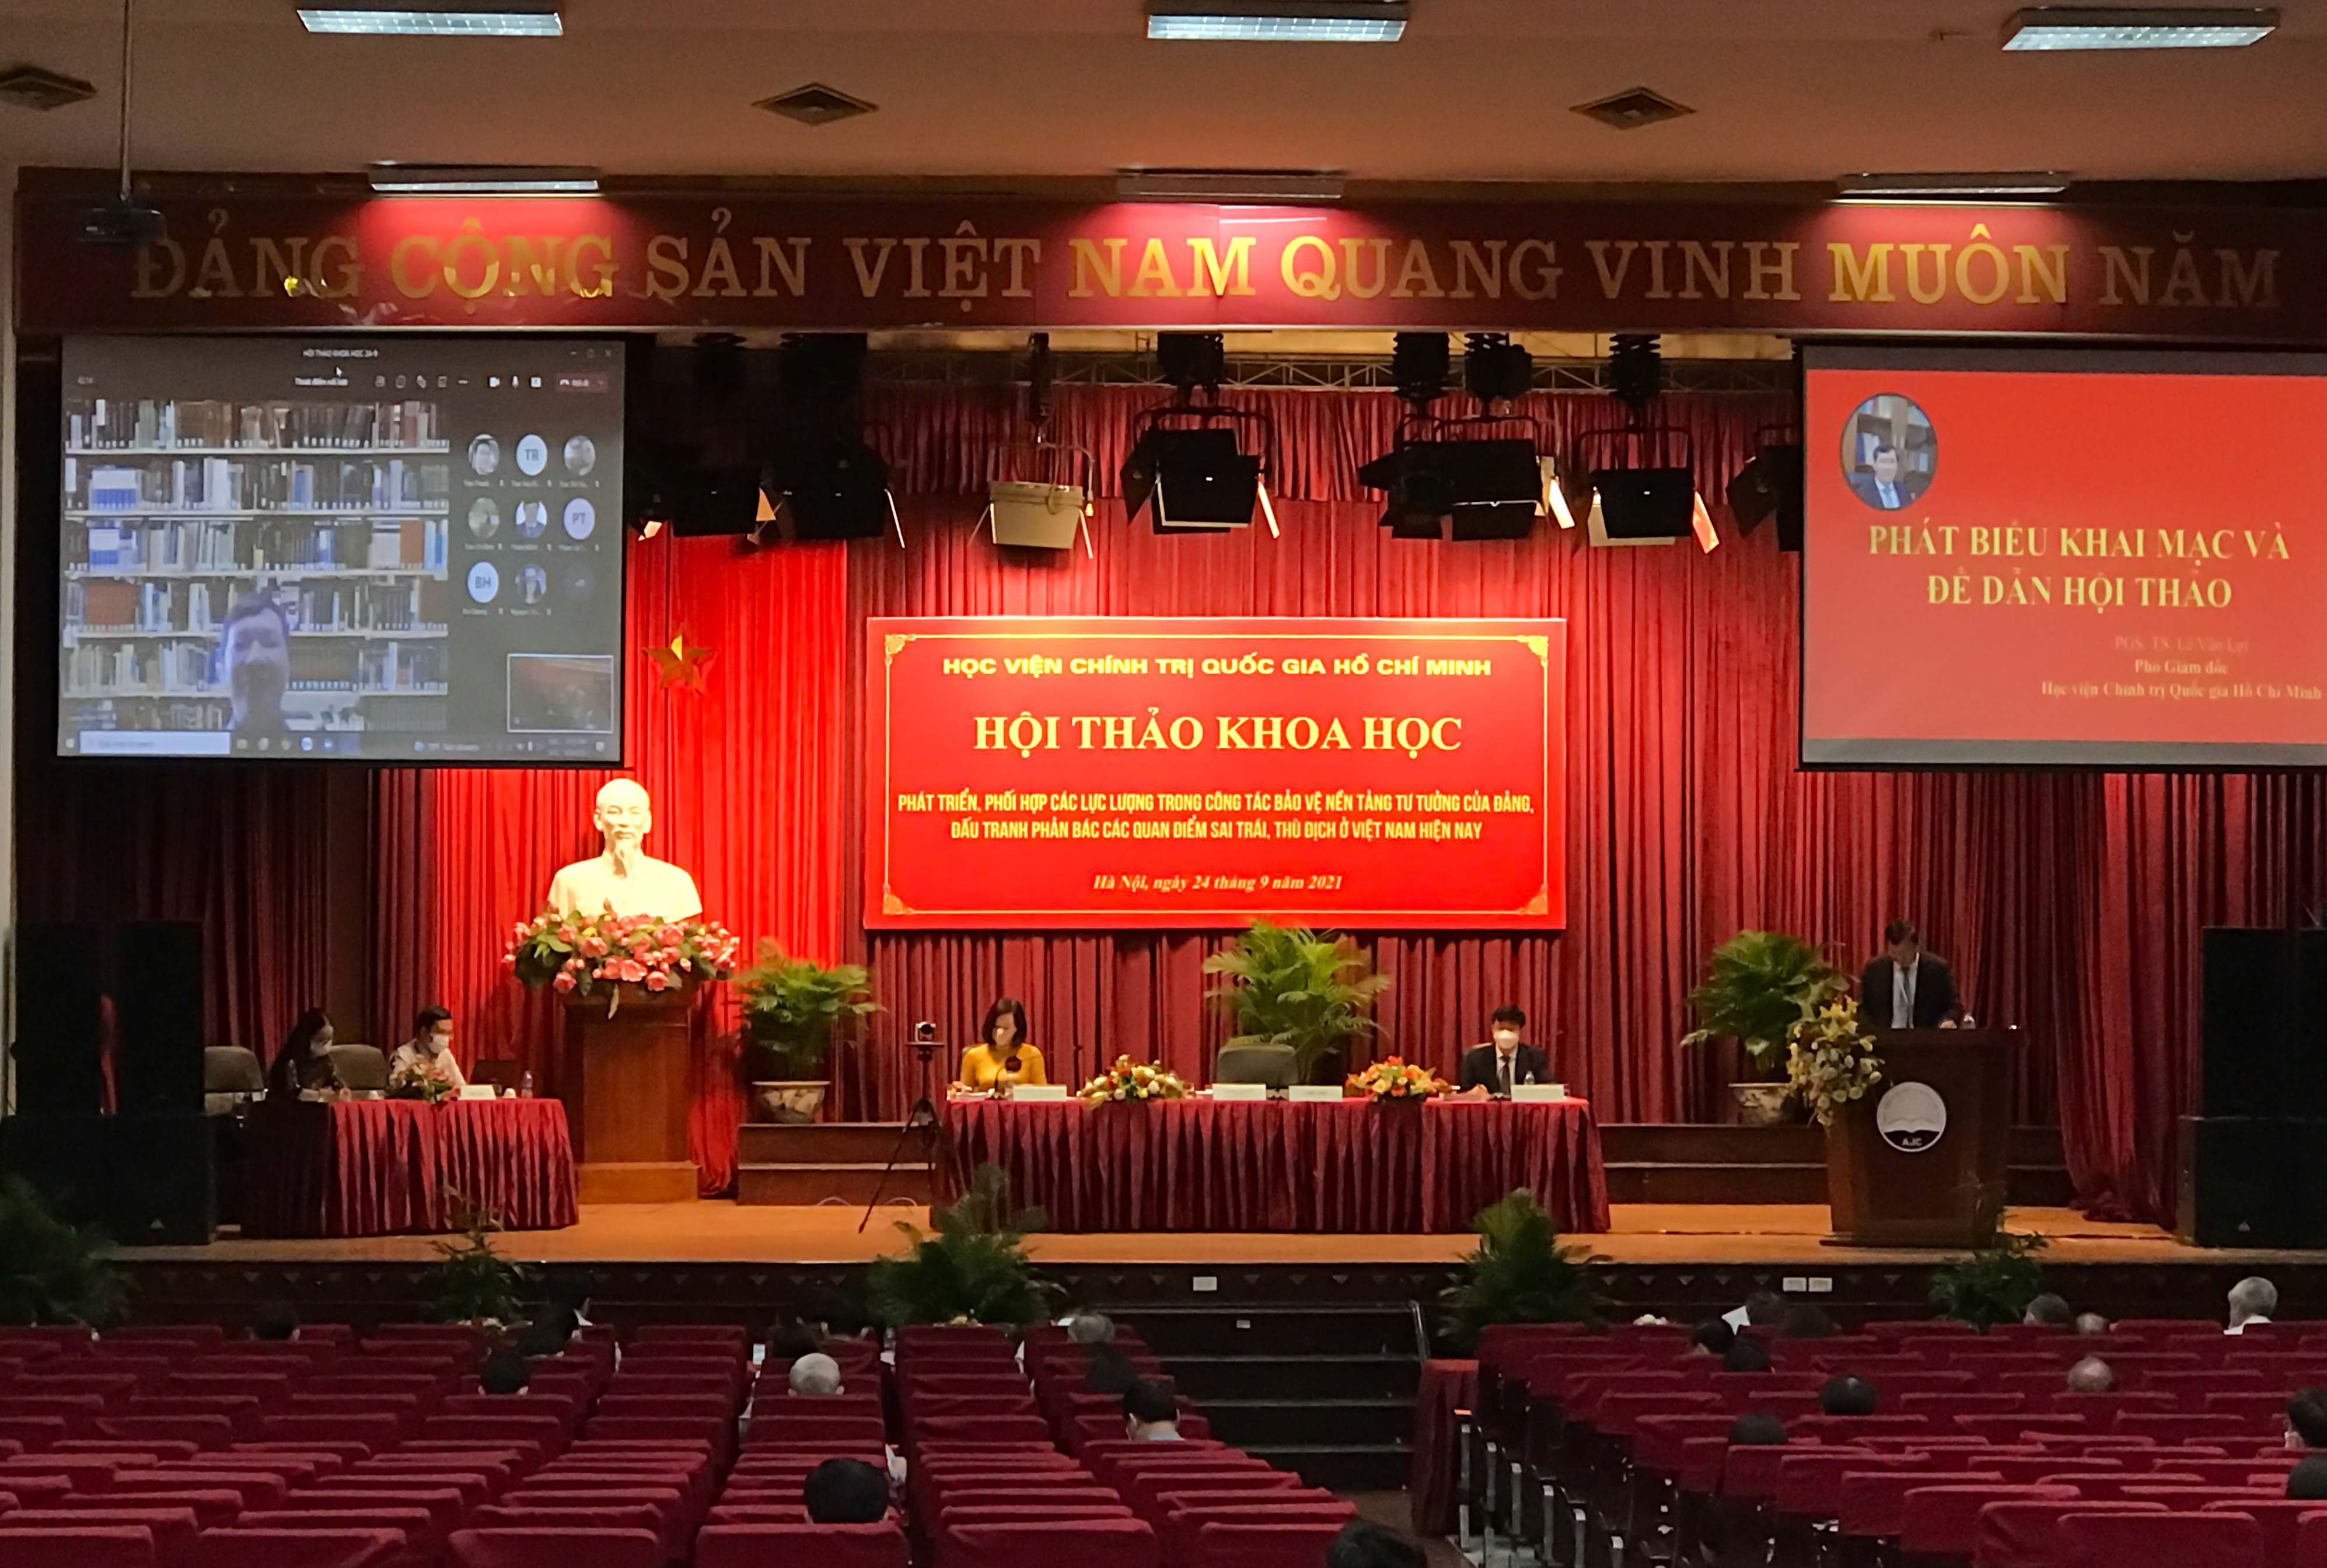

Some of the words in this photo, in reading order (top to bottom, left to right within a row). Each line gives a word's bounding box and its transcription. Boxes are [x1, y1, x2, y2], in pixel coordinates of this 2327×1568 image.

[130, 208, 365, 299] ĐẢNG
[389, 217, 616, 314] CỘNG
[645, 208, 812, 300] SẢN
[843, 219, 1041, 312] VIỆT
[1068, 235, 1257, 298] NAM
[1280, 235, 1564, 301] QUANG
[1585, 240, 1802, 301] VINH
[1827, 223, 2070, 305] MUÔN
[2098, 231, 2281, 308] NĂM
[525, 448, 539, 461] TR
[572, 512, 586, 525] PT
[1870, 517, 1959, 555] PHÁT
[2060, 528, 2145, 557] KHAI
[2157, 528, 2235, 567] MẠC
[2244, 522, 2290, 560] VÀ
[2064, 571, 2124, 614] HỘI
[2134, 569, 2232, 608] THẢO
[943, 658, 997, 679] HỌC
[1004, 654, 1063, 679] VIỆN
[1070, 654, 1148, 675] CHÍNH
[1155, 658, 1194, 679] TRỊ
[1201, 652, 1274, 675] QUỐC
[1281, 658, 1326, 675] GIA
[1333, 653, 1369, 675] HỒ
[1376, 655, 1420, 675] CHÍ
[1426, 659, 1491, 676] MINH
[2209, 684, 2228, 700] gia
[2286, 684, 2322, 700] Minh
[973, 711, 1061, 759] HỘI
[1071, 707, 1204, 750] THẢO
[1215, 717, 1353, 750] KHOA
[1361, 717, 1462, 759] HỌC
[898, 790, 935, 812] PHÁT
[937, 787, 982, 813] TRIỂN,
[985, 789, 1017, 812] PHỐI
[1019, 793, 1048, 815] HỢP
[1050, 790, 1078, 812] CÁC
[1080, 792, 1107, 815] LỰC
[1109, 792, 1155, 815] LƯỢNG
[1157, 794, 1202, 812] TRONG
[1205, 791, 1242, 812] CÔNG
[1245, 790, 1271, 812] TÁC
[1274, 788, 1302, 812] BẢO
[1304, 791, 1323, 815] VỆ
[1325, 788, 1353, 812] NỀN
[1357, 789, 1392, 812] TẢNG
[1395, 792, 1413, 812] TƯ
[1416, 790, 1461, 812] TƯỞNG
[1463, 790, 1490, 812] CỦA
[1493, 790, 1535, 815] ĐẢNG,
[951, 816, 979, 839] ĐẤU
[982, 820, 1029, 839] TRANH
[1031, 816, 1069, 839] PHẢN
[1072, 818, 1100, 839] BÁC
[1102, 818, 1130, 839] CÁC
[1133, 821, 1170, 839] QUAN
[1172, 815, 1208, 839] ĐIỂM
[1210, 821, 1233, 839] SAI
[1236, 818, 1271, 840] TRÁI,
[1274, 818, 1301, 839] THÙ
[1304, 821, 1336, 842] ĐỊCH
[1339, 816, 1350, 839] Ở
[1351, 818, 1382, 842] VIỆT
[1384, 822, 1416, 839] NAM
[1418, 818, 1451, 842] HIỆN
[1453, 822, 1483, 839] NAY
[1093, 875, 1116, 890] Hà
[1120, 875, 1149, 893] Nội,
[1152, 875, 1188, 893] ngày
[1192, 875, 1211, 890] 24
[1213, 875, 1256, 893] tháng
[1259, 875, 1270, 890] 9
[1272, 875, 1305, 890] năm
[1308, 875, 1343, 890] 2021
[1902, 1137, 1923, 1147] AJC
